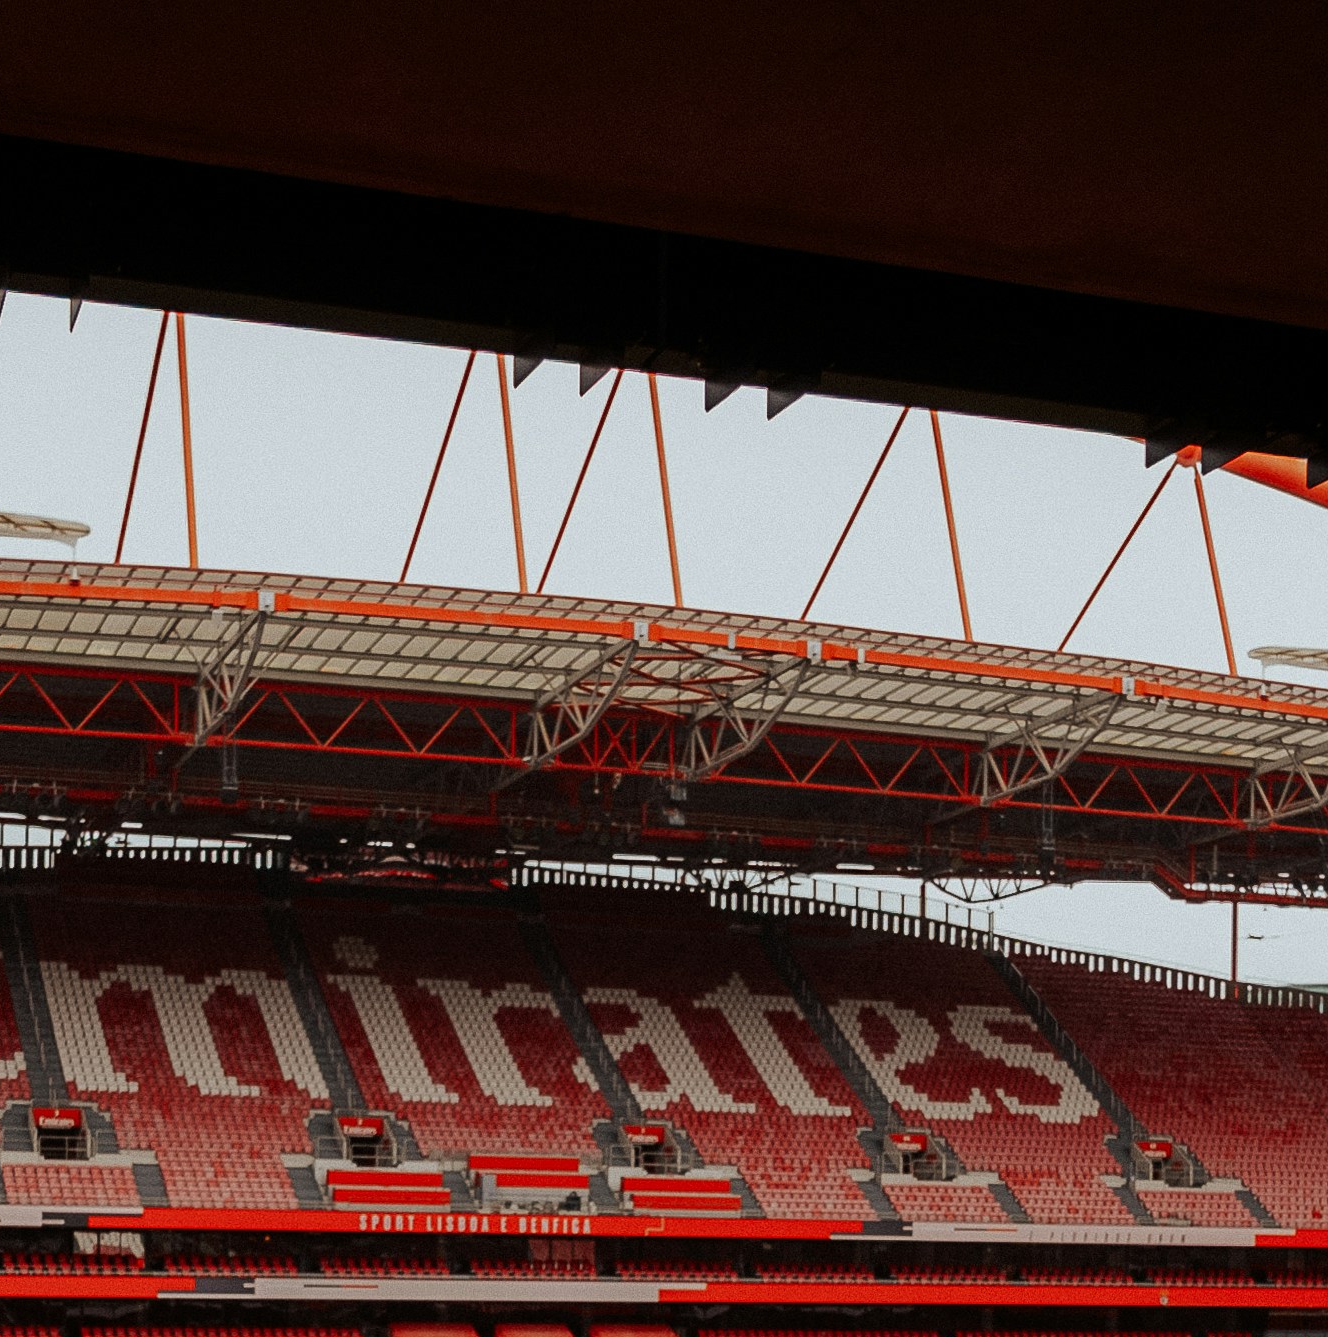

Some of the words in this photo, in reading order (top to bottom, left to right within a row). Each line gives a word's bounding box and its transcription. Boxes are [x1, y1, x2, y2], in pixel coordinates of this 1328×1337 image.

[359, 1213, 415, 1232] SPORT
[426, 1215, 489, 1233] LISBOA
[500, 1216, 508, 1233] E
[518, 1217, 591, 1235] BENFICA
